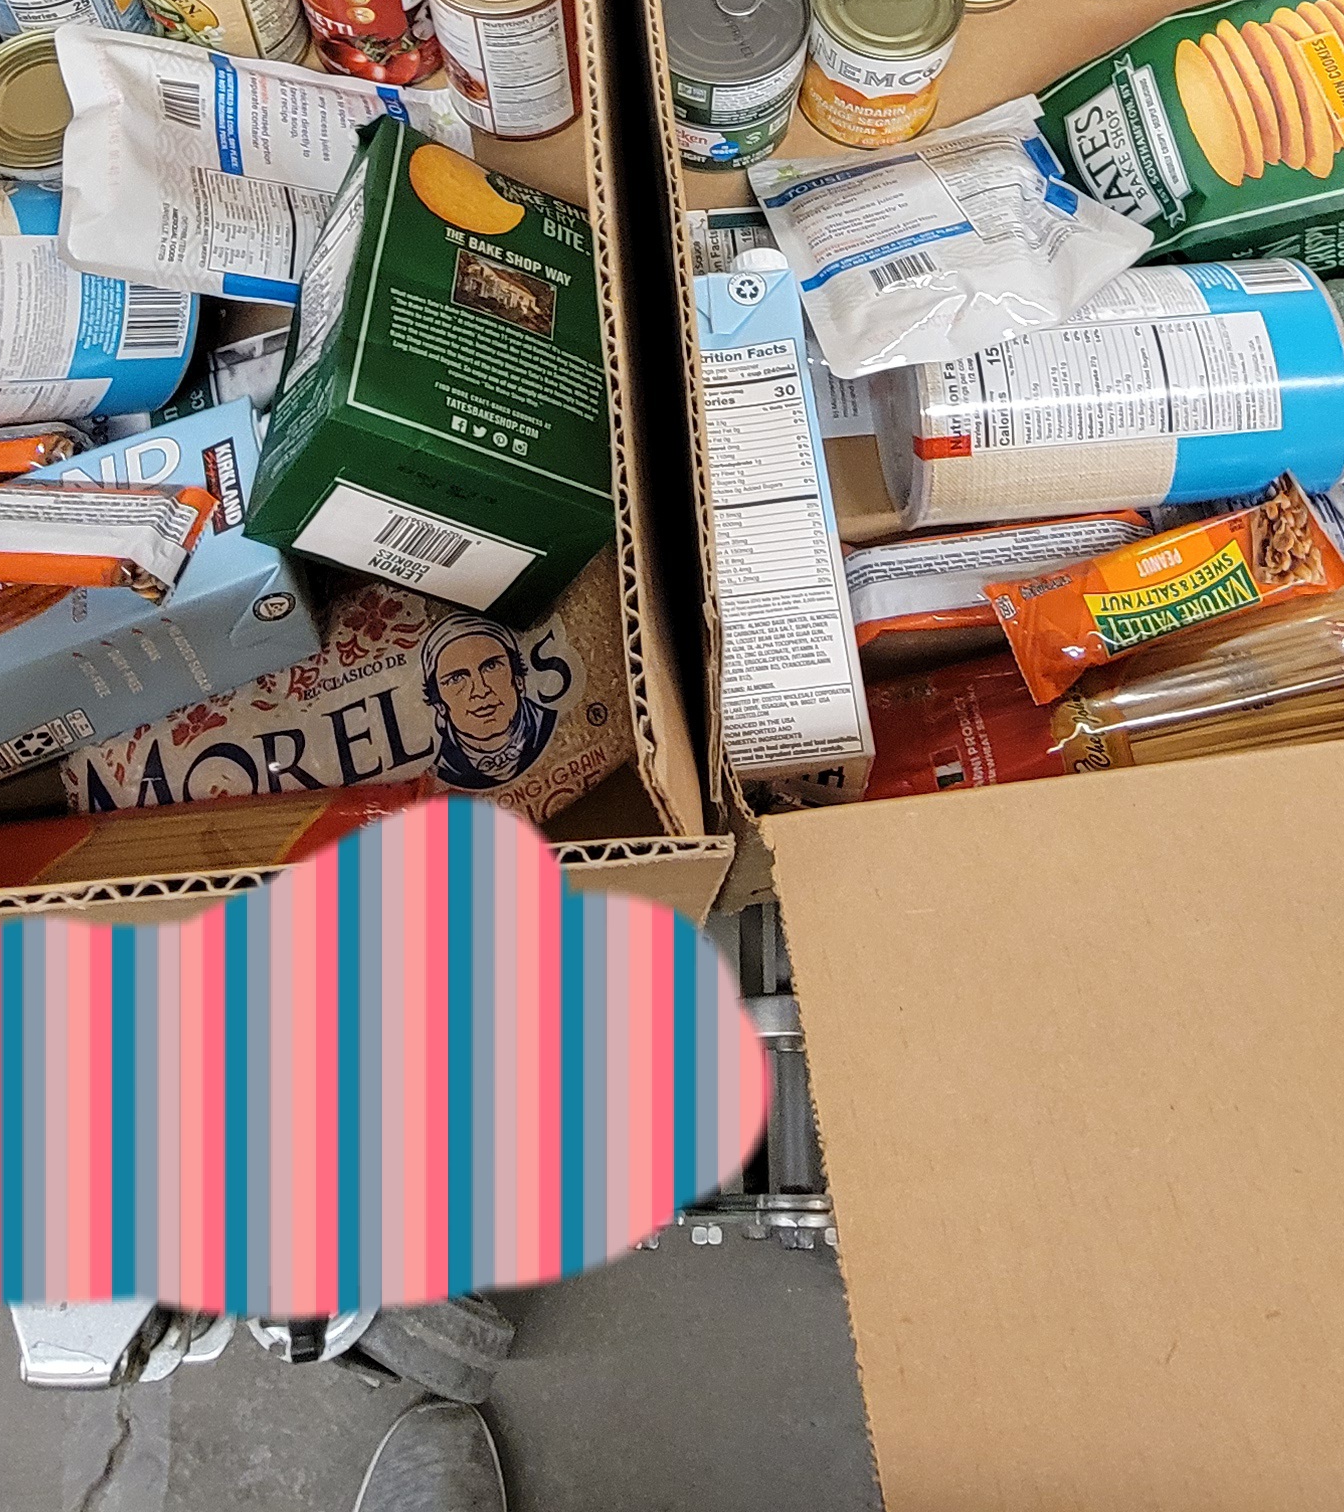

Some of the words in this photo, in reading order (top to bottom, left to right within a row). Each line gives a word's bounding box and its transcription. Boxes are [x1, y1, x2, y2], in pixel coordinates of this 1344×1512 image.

[16, 10, 58, 21] Calories
[482, 18, 530, 29] Nutrition
[531, 6, 557, 23] Facts
[1312, 39, 1340, 79] COOKIES
[280, 95, 288, 123] recipe
[834, 95, 906, 118] MANDARIN
[250, 108, 258, 149] container
[1106, 110, 1125, 150] SHOP
[262, 134, 271, 165] portion
[321, 133, 330, 162] juices
[786, 186, 807, 198] TO
[1119, 152, 1148, 200] BAKE
[535, 204, 576, 228] VERY
[543, 217, 591, 256] BITE.
[445, 226, 466, 246] THE
[468, 237, 504, 261] BAKE
[505, 250, 542, 274] SHOP
[544, 265, 572, 287] WAY
[701, 352, 742, 363] rition
[747, 343, 787, 359] Facts
[747, 370, 762, 378] cup
[763, 363, 795, 376] (240mL)
[705, 397, 735, 407] ories
[774, 384, 796, 397] 30
[445, 396, 540, 439] TATESBAKESHOP.COM
[214, 442, 245, 527] KIRKLAND
[368, 555, 424, 584] LEMON
[375, 548, 431, 574] COOKIES
[1136, 546, 1184, 579] PEANUT
[1187, 551, 1234, 590] SWEET
[1100, 595, 1133, 612] NUT
[1136, 585, 1179, 610] SALTY
[1176, 569, 1256, 621] NATURE
[1105, 607, 1174, 647] VALLEY
[322, 660, 383, 692] CLASICO
[386, 653, 407, 668] DE
[87, 631, 572, 813] MORELS
[555, 745, 608, 787] GRAIN
